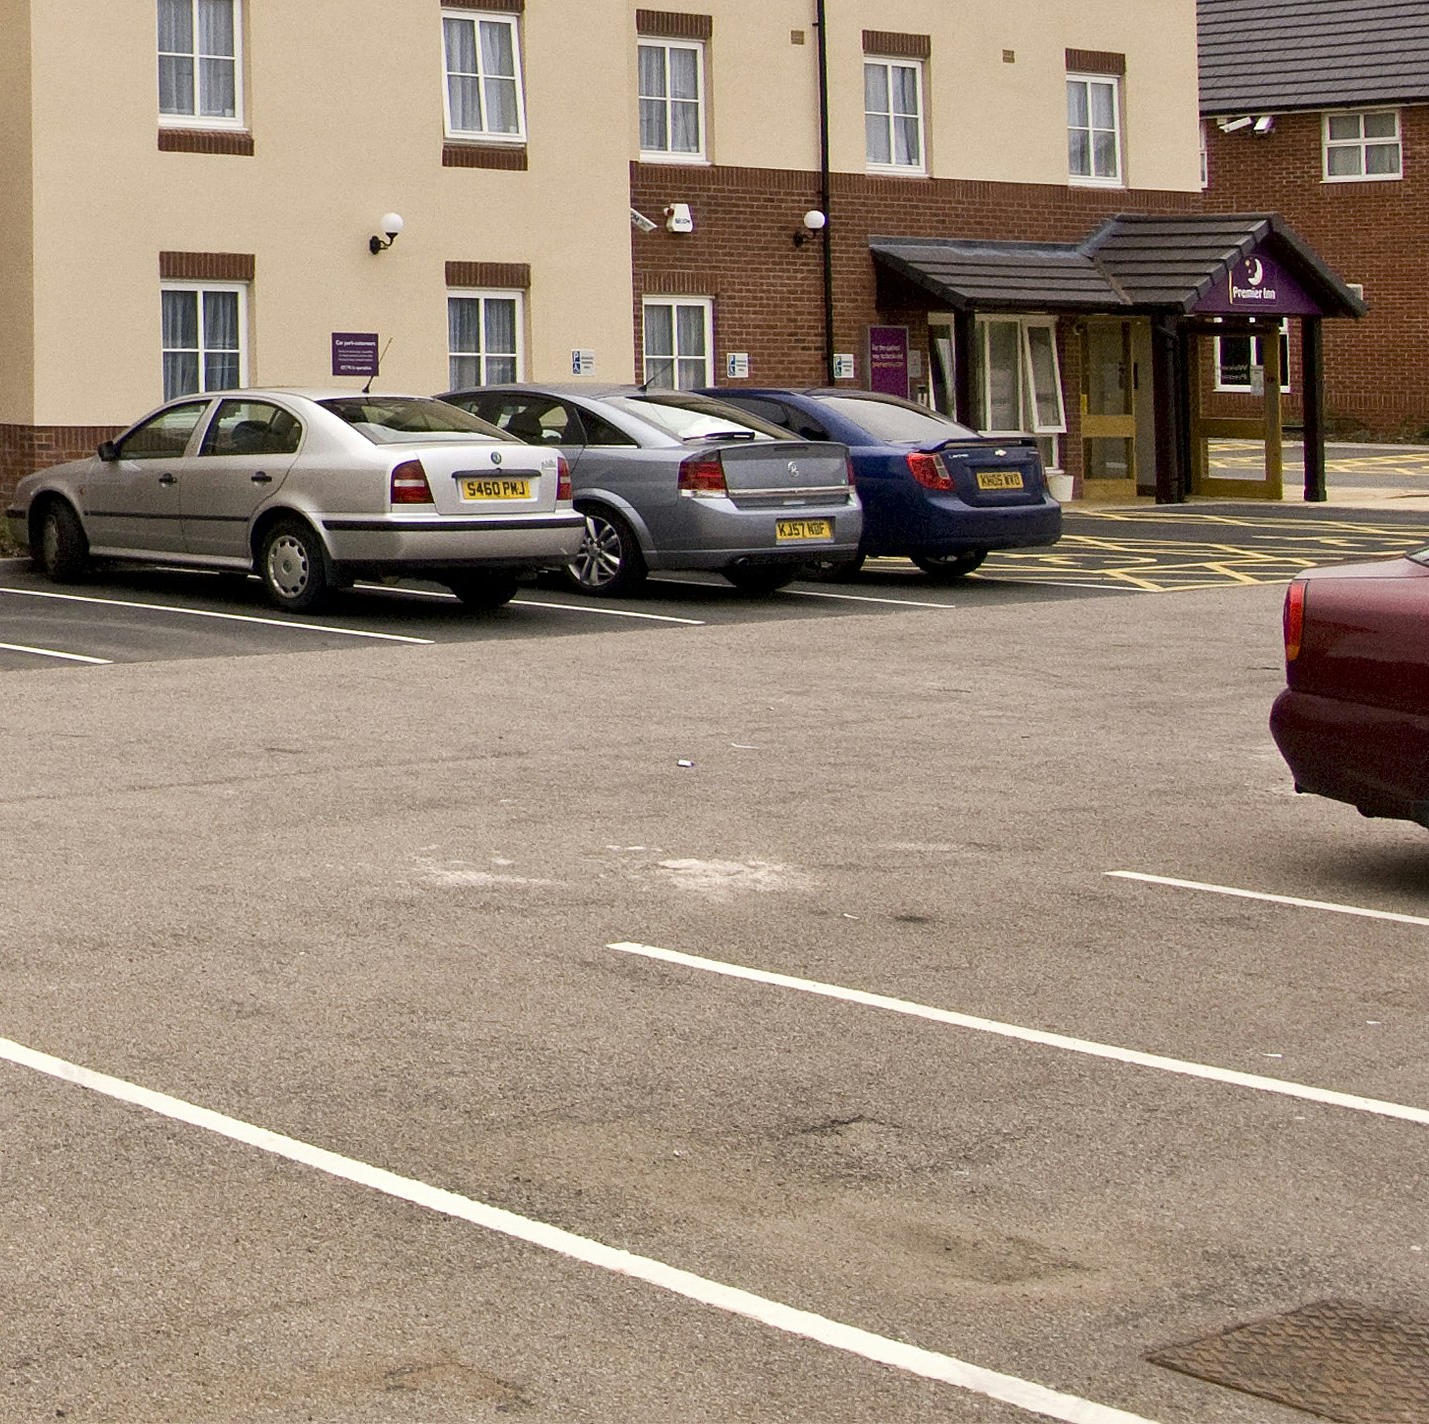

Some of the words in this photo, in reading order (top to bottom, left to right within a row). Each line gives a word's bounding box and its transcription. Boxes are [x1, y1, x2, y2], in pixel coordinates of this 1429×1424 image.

[1233, 286, 1262, 299] Premier
[1263, 287, 1276, 299] Inn
[467, 482, 500, 497] S460
[502, 481, 525, 496] PMJ
[777, 522, 805, 537] KJ57
